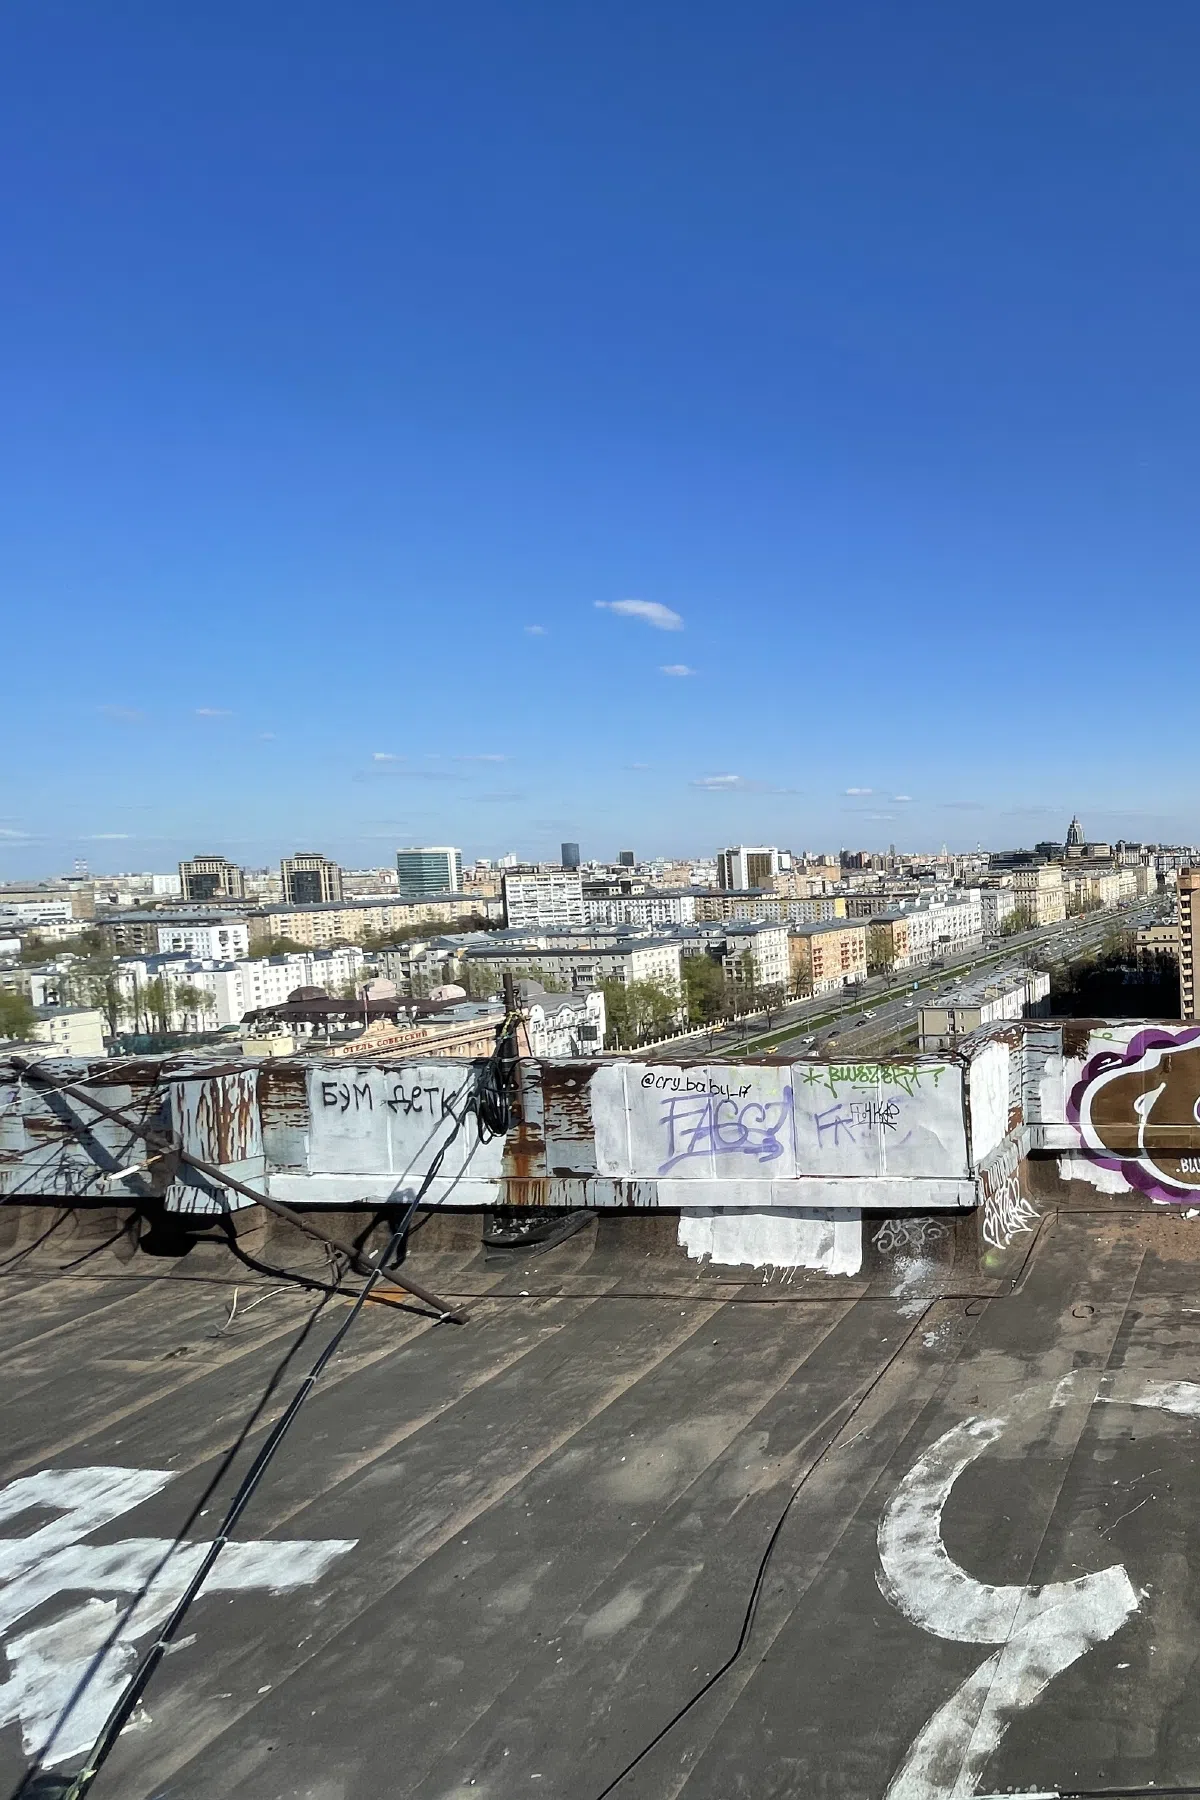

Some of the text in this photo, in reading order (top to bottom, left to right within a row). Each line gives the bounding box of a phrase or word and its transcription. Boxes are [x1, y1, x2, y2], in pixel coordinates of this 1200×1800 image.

[343, 1044, 374, 1054] ОТЕЛЬ
[321, 1081, 373, 1114] БУМ
[641, 1073, 752, 1099] @cry_baby_17
